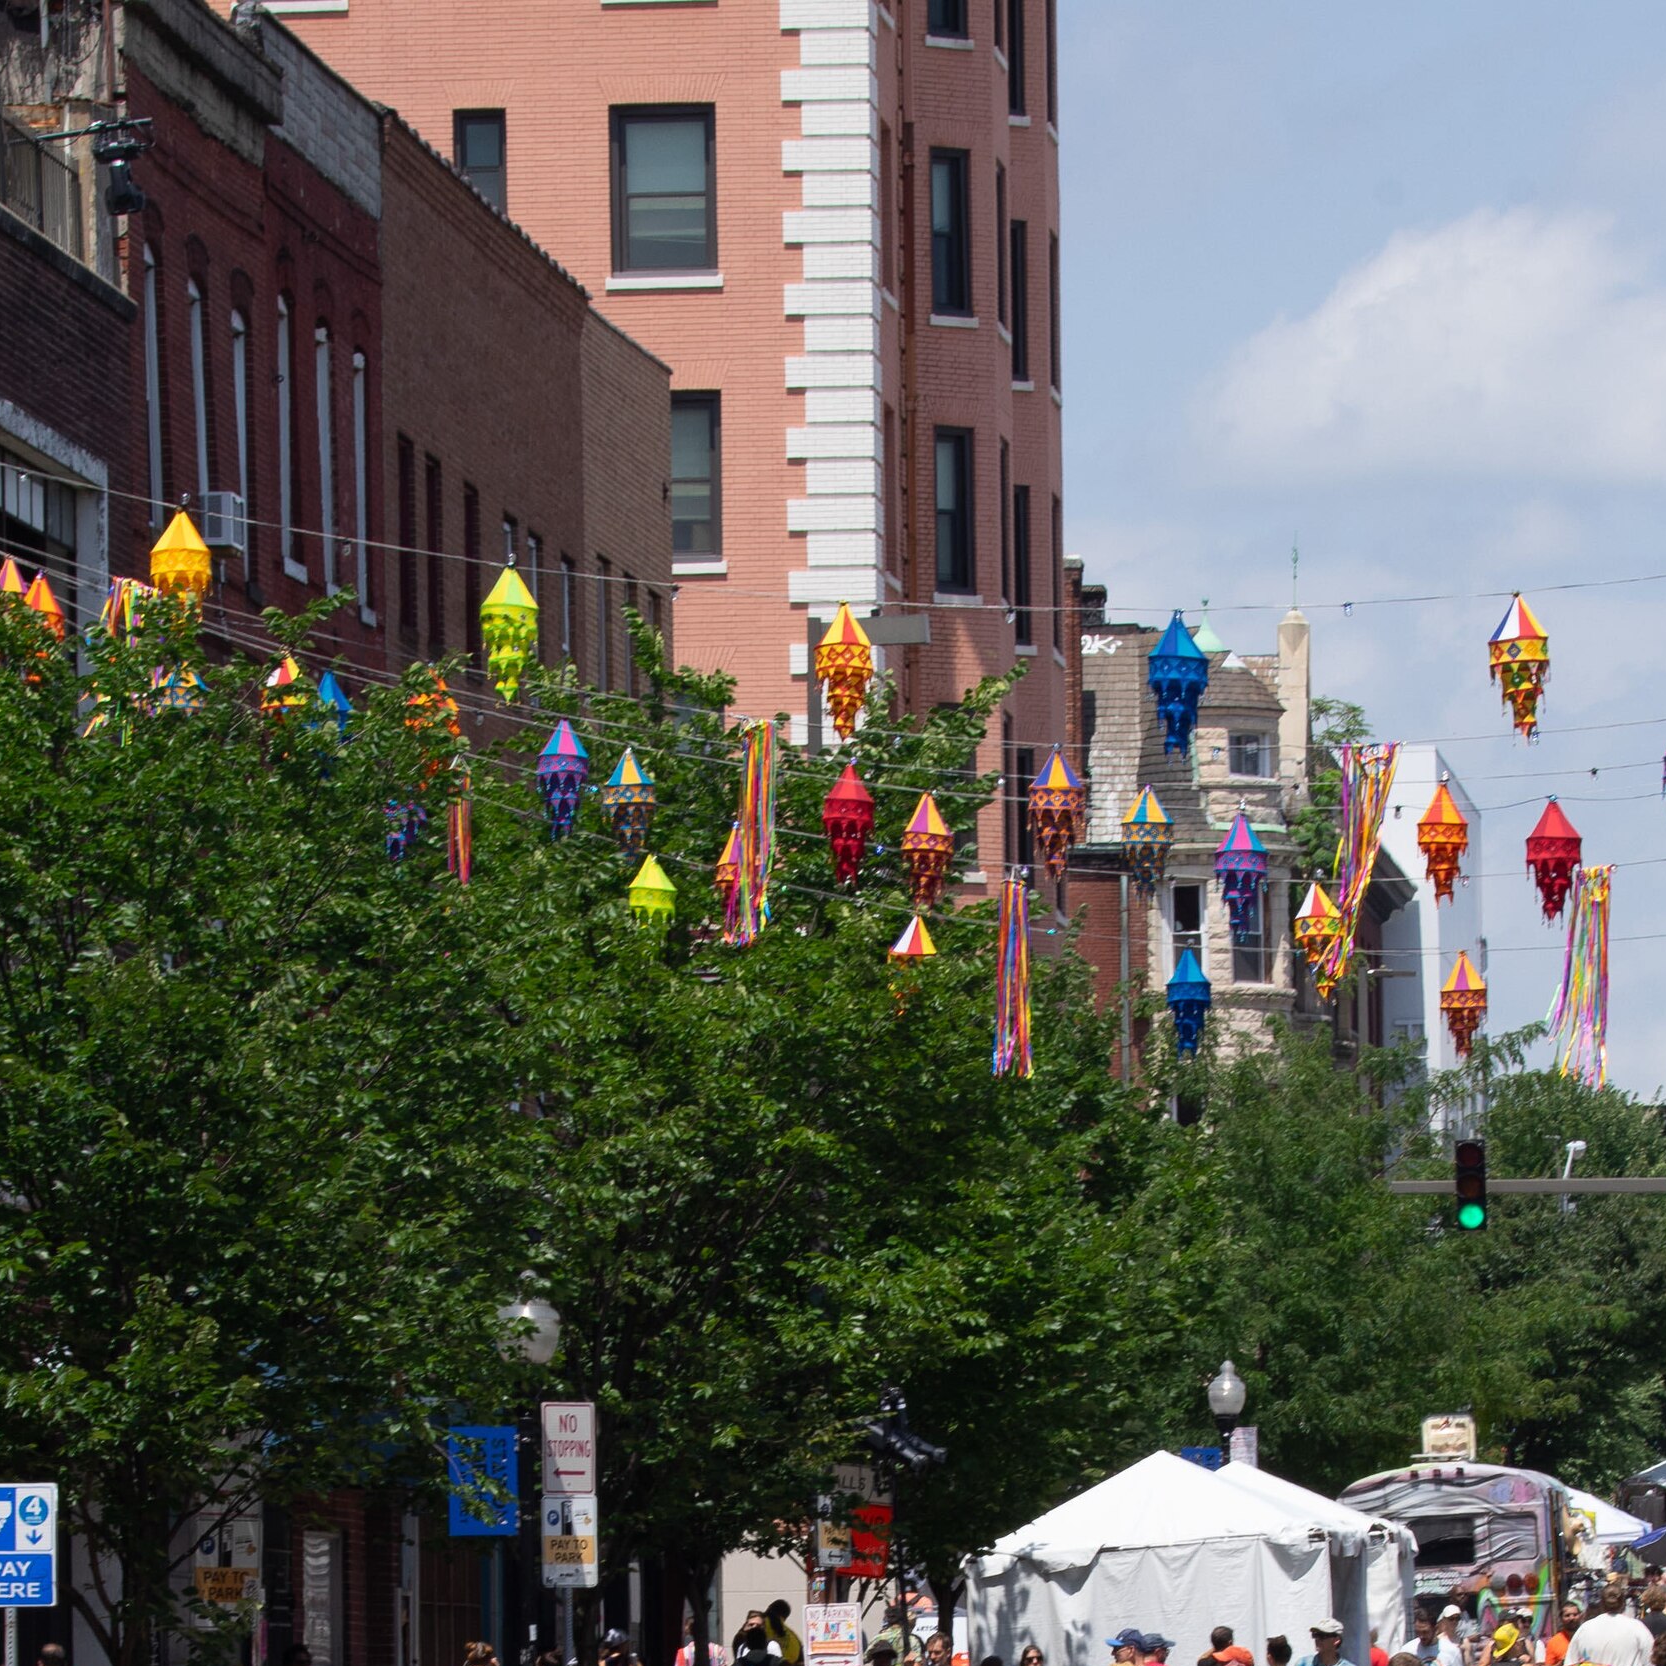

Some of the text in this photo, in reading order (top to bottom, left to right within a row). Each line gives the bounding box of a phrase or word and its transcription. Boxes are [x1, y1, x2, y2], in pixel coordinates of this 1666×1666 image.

[558, 1413, 578, 1433] NO
[547, 1439, 592, 1458] STOPPING
[25, 1496, 42, 1516] 4
[550, 1538, 588, 1551] PAY TO
[554, 1551, 583, 1563] PARK
[203, 1571, 227, 1581] PAY
